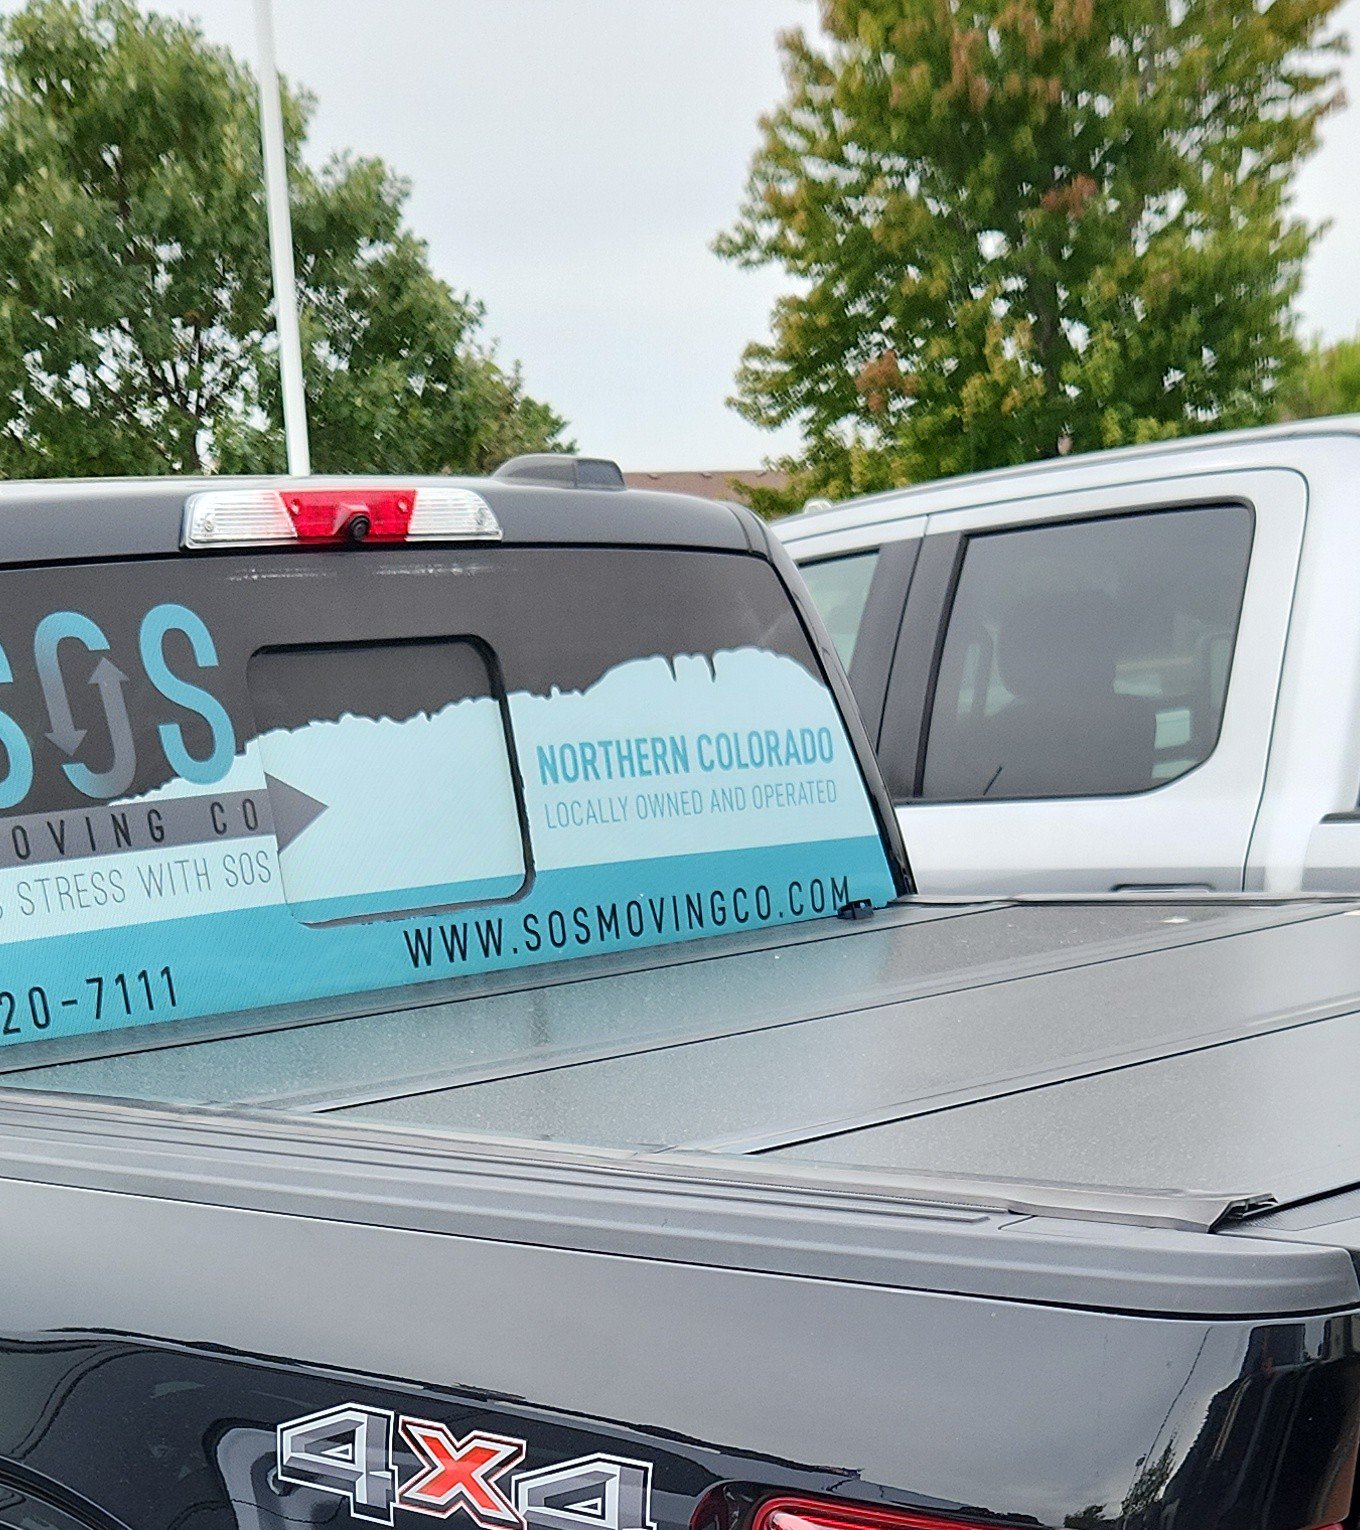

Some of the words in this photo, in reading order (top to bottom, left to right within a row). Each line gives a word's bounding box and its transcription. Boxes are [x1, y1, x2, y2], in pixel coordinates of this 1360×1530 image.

[536, 734, 689, 786] NORTHERN
[697, 726, 835, 774] COLORADO
[210, 798, 260, 835] CO
[544, 795, 628, 830] LOCALLY
[635, 788, 703, 822] OWNED
[710, 786, 746, 813] AND
[751, 779, 837, 811] OPERATED
[19, 869, 126, 917] STRESS
[139, 857, 212, 898] WITH
[223, 850, 272, 887] SOS
[403, 875, 851, 969] WWW.SOSMOVINGCO.COM
